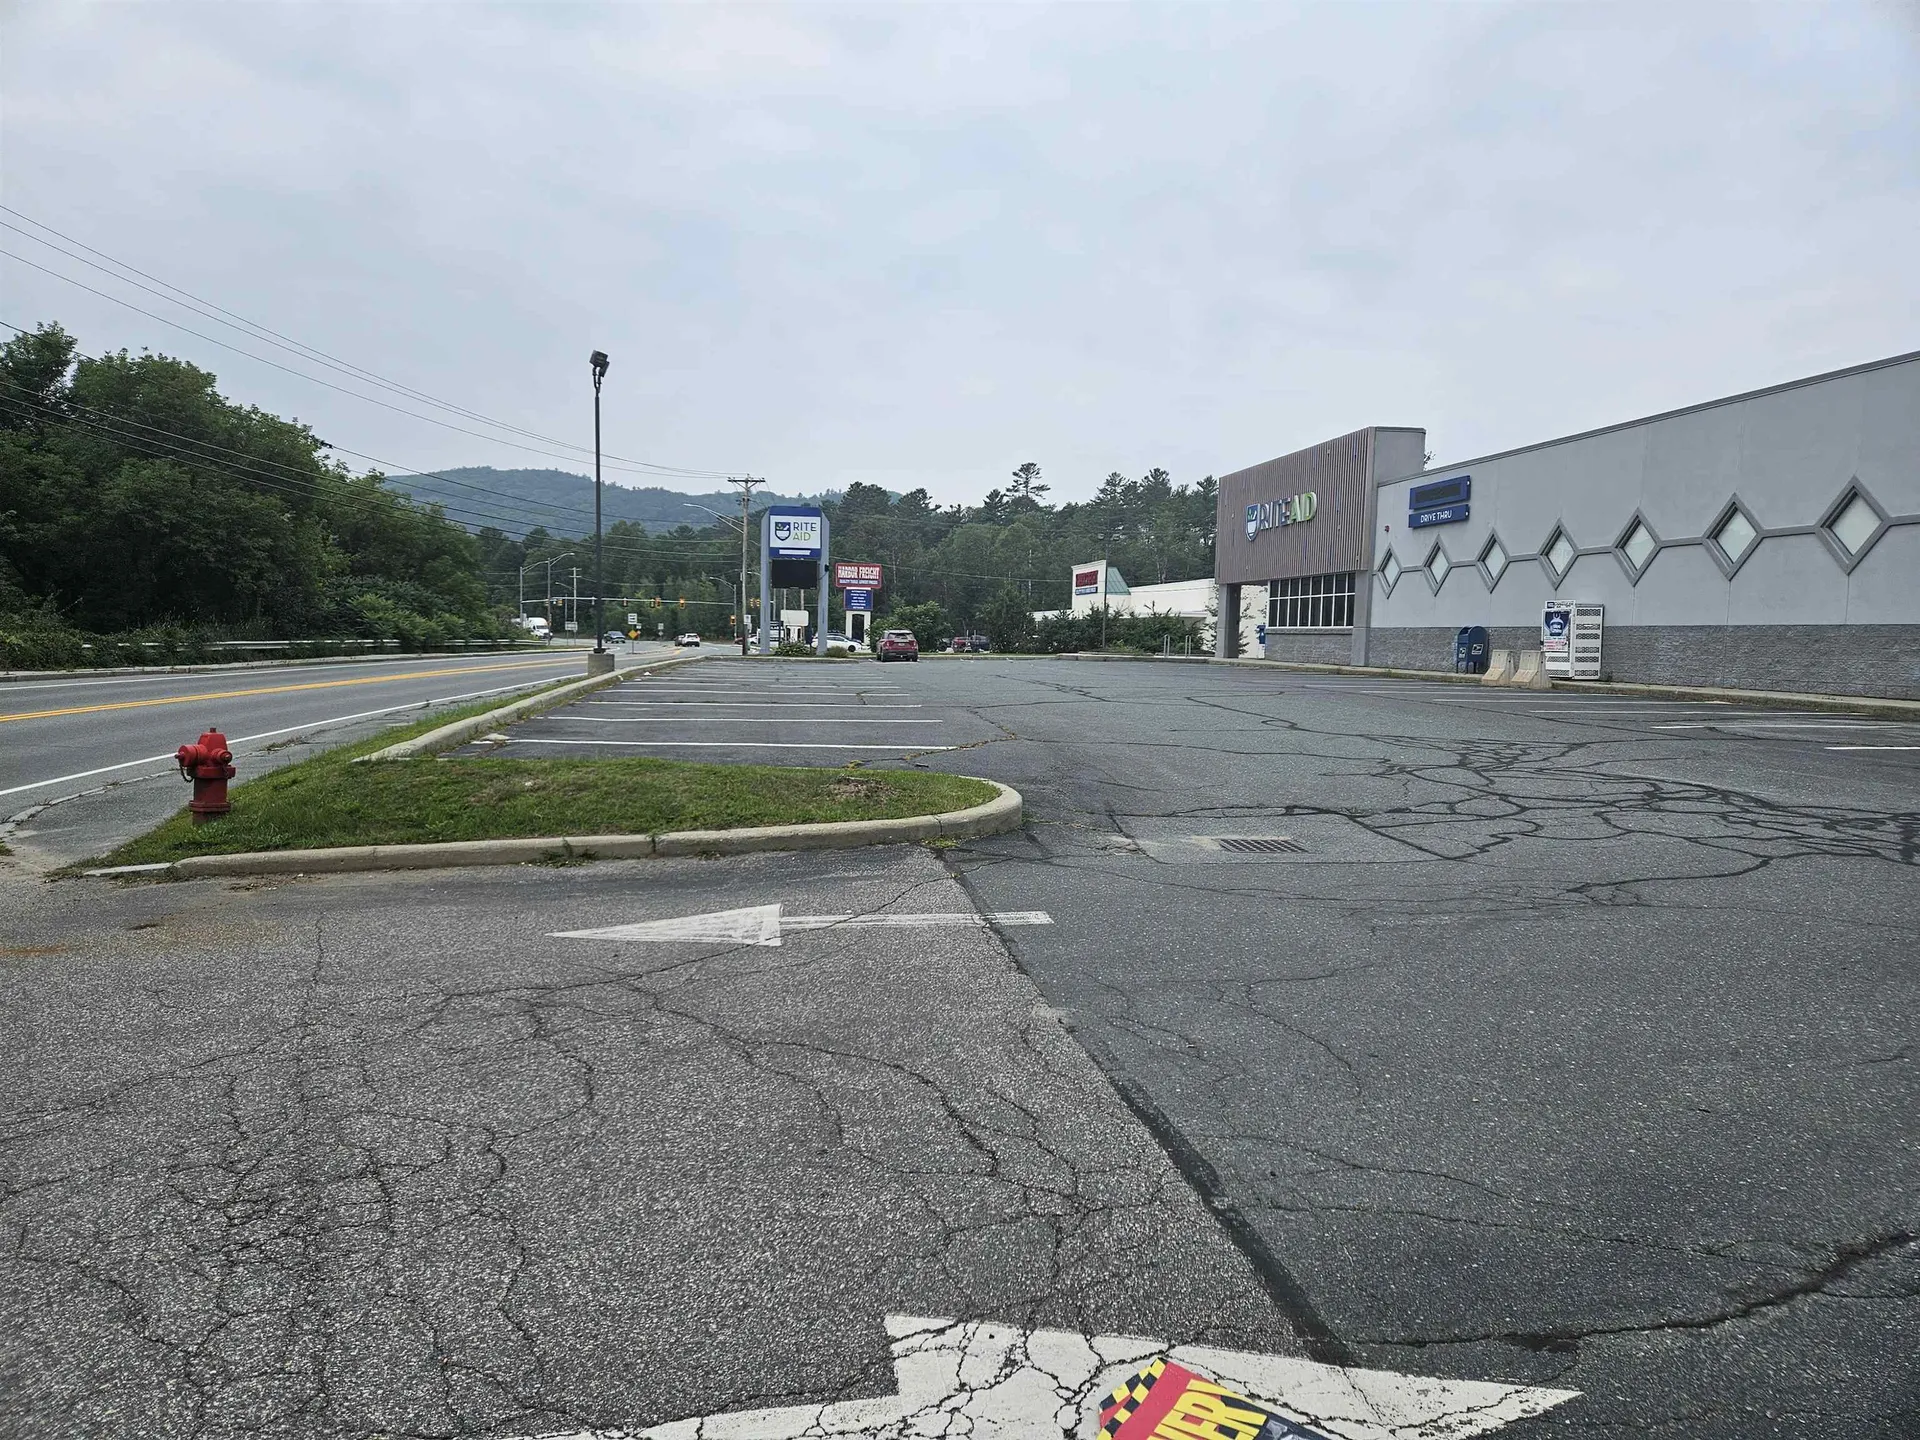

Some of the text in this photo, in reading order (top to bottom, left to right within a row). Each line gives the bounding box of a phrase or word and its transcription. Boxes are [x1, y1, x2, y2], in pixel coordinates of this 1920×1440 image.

[1260, 497, 1291, 530] RITE
[1420, 509, 1453, 523] DRIVE THRU
[793, 521, 817, 532] RITE
[792, 532, 812, 541] AID
